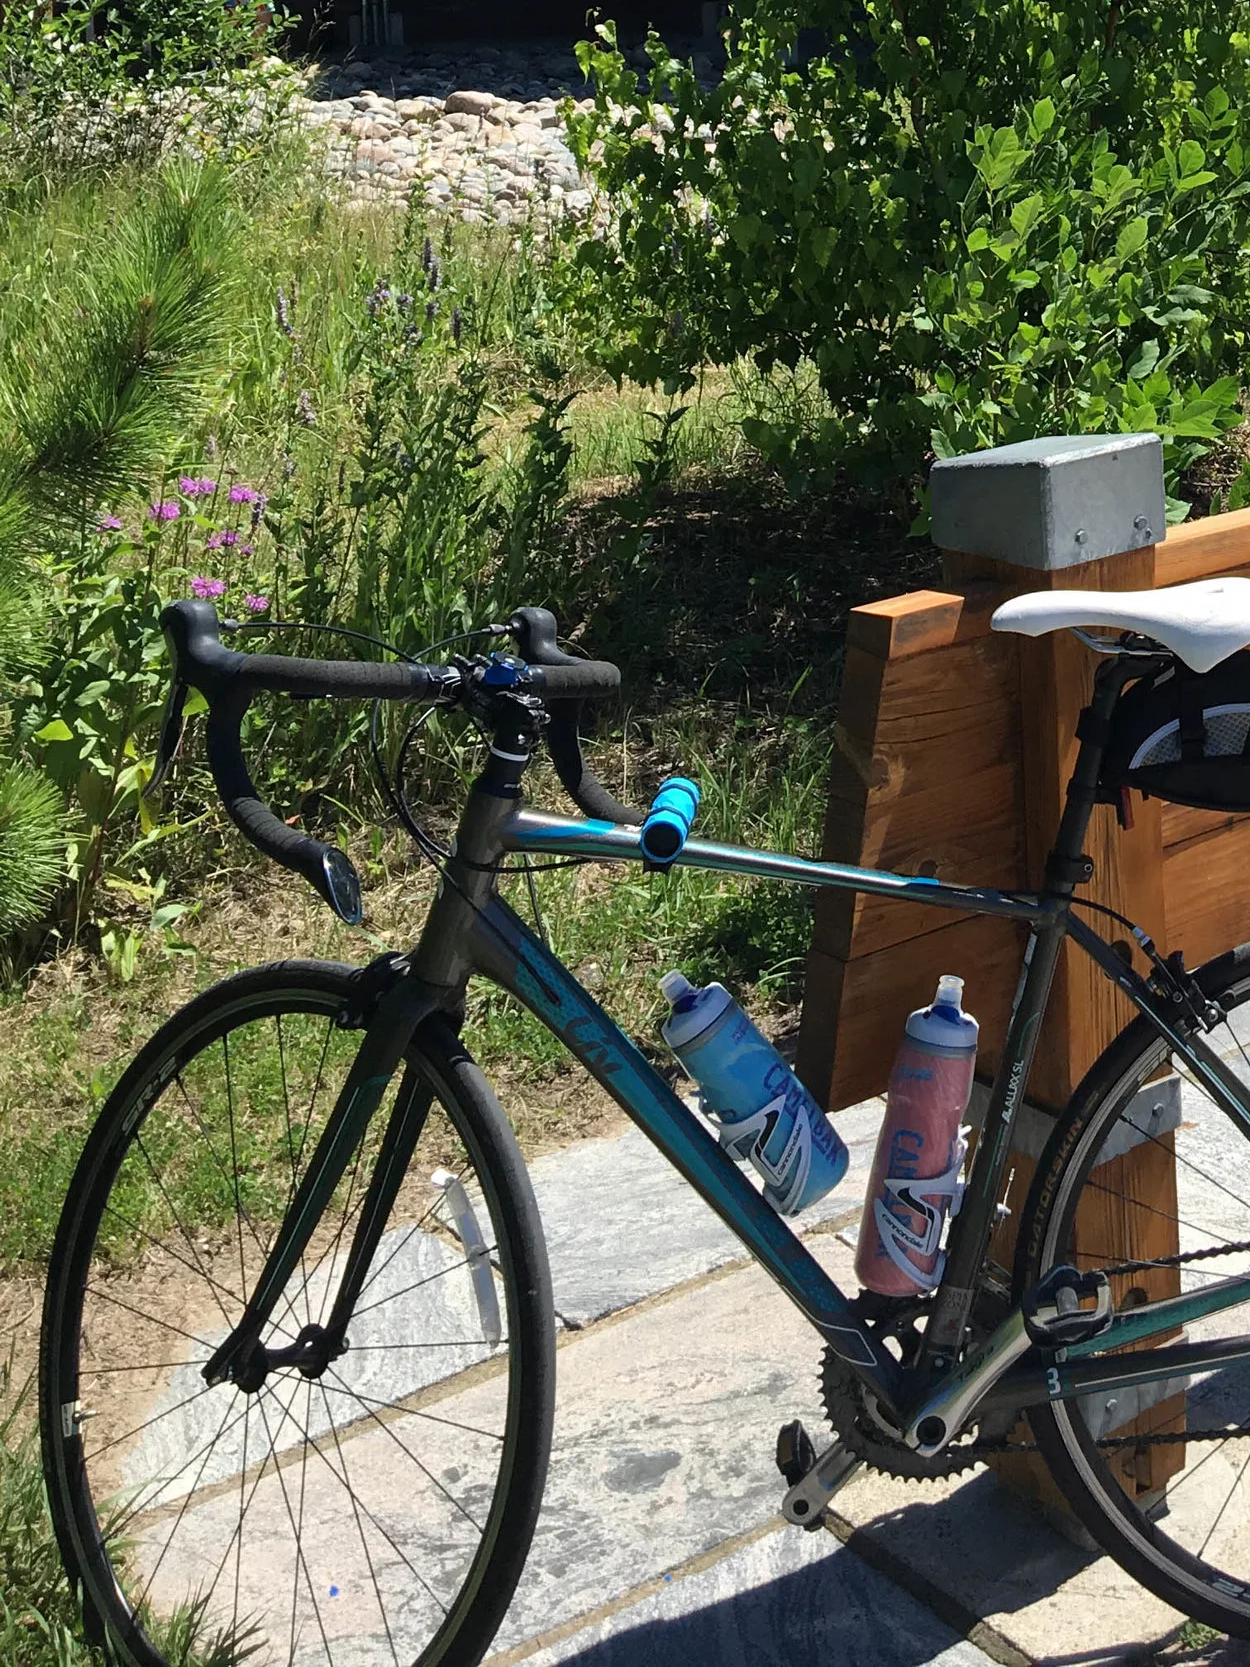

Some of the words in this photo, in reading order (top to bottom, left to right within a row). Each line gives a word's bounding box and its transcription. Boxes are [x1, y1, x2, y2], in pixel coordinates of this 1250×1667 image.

[1003, 1073, 1021, 1110] ALUXX
[1012, 1059, 1025, 1073] SL
[1046, 1367, 1062, 1395] 3
